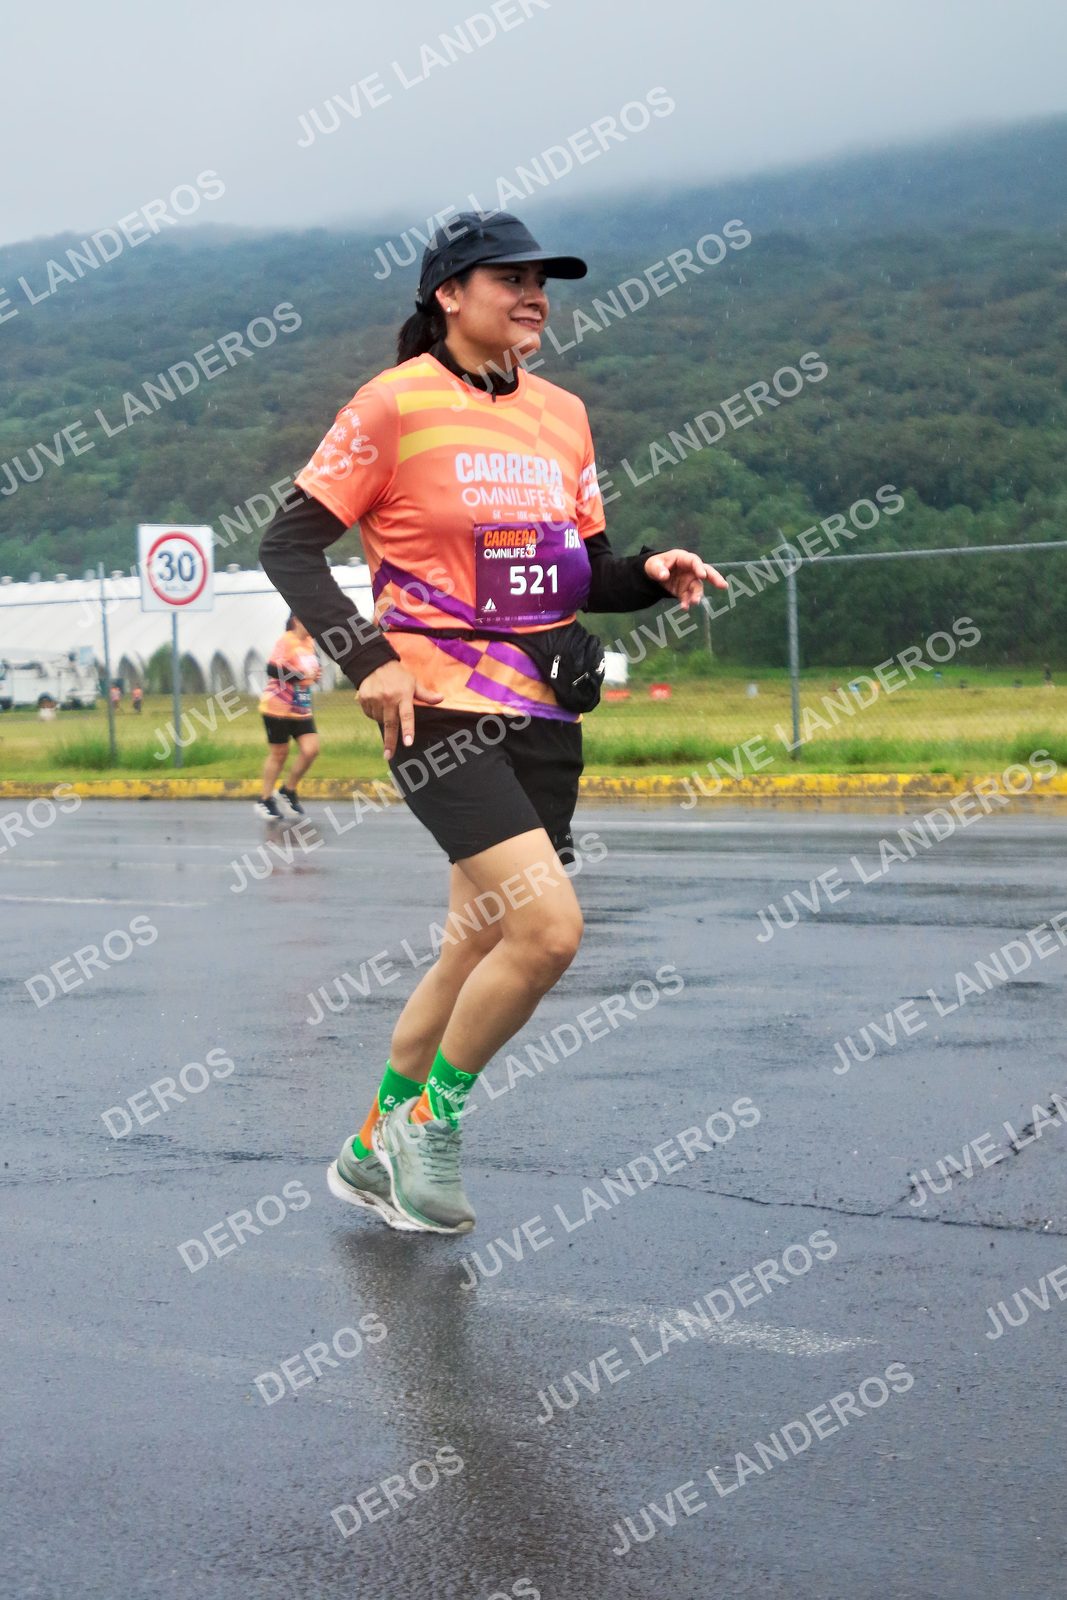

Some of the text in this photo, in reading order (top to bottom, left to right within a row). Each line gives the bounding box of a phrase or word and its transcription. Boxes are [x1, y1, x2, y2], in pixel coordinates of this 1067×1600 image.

[455, 452, 563, 487] CARRERA
[462, 486, 548, 509] OMNILIFE
[484, 529, 536, 547] CARRERA
[158, 550, 196, 582] 30
[484, 547, 525, 559] OMNILIFE
[509, 564, 558, 596] 521
